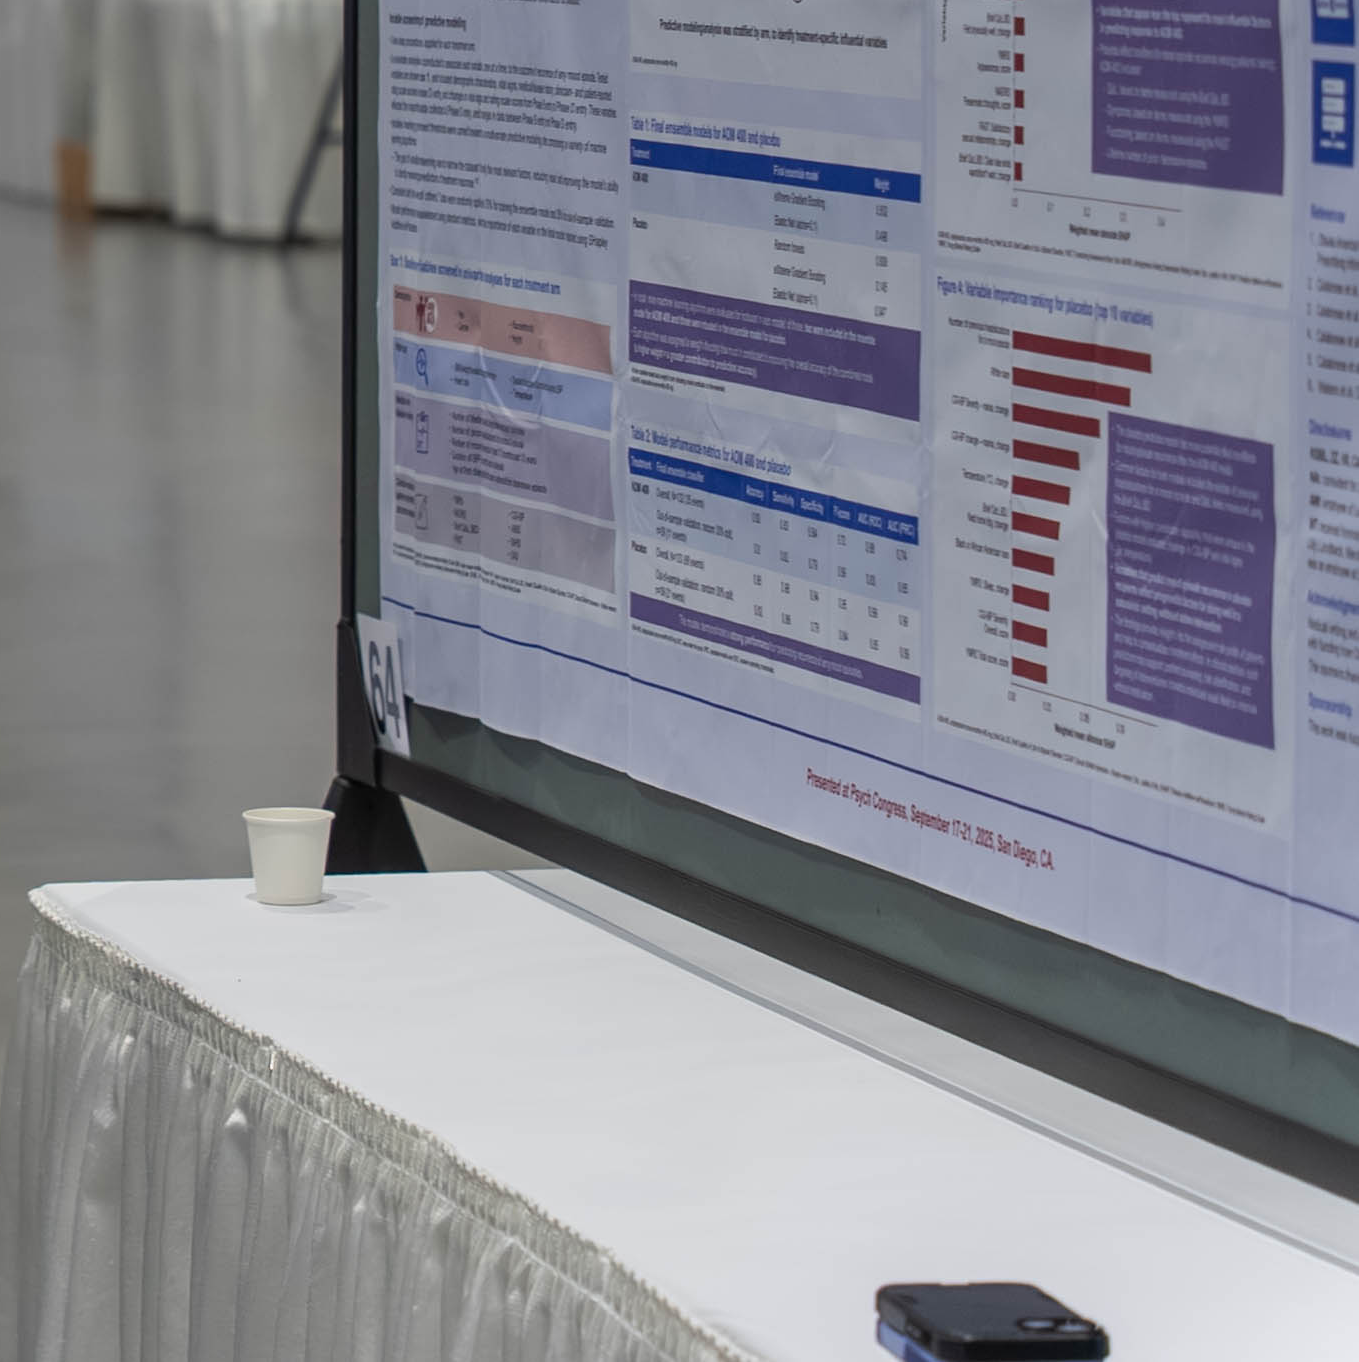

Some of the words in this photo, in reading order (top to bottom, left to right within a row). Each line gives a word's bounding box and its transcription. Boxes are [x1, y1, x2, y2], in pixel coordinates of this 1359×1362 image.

[368, 640, 401, 739] 64
[807, 767, 841, 796] Presented
[841, 783, 850, 799] at
[851, 783, 871, 808] Psych
[873, 791, 909, 822] Congress,
[911, 804, 950, 834] September
[997, 834, 1012, 856] San
[1013, 839, 1039, 869] Diego,
